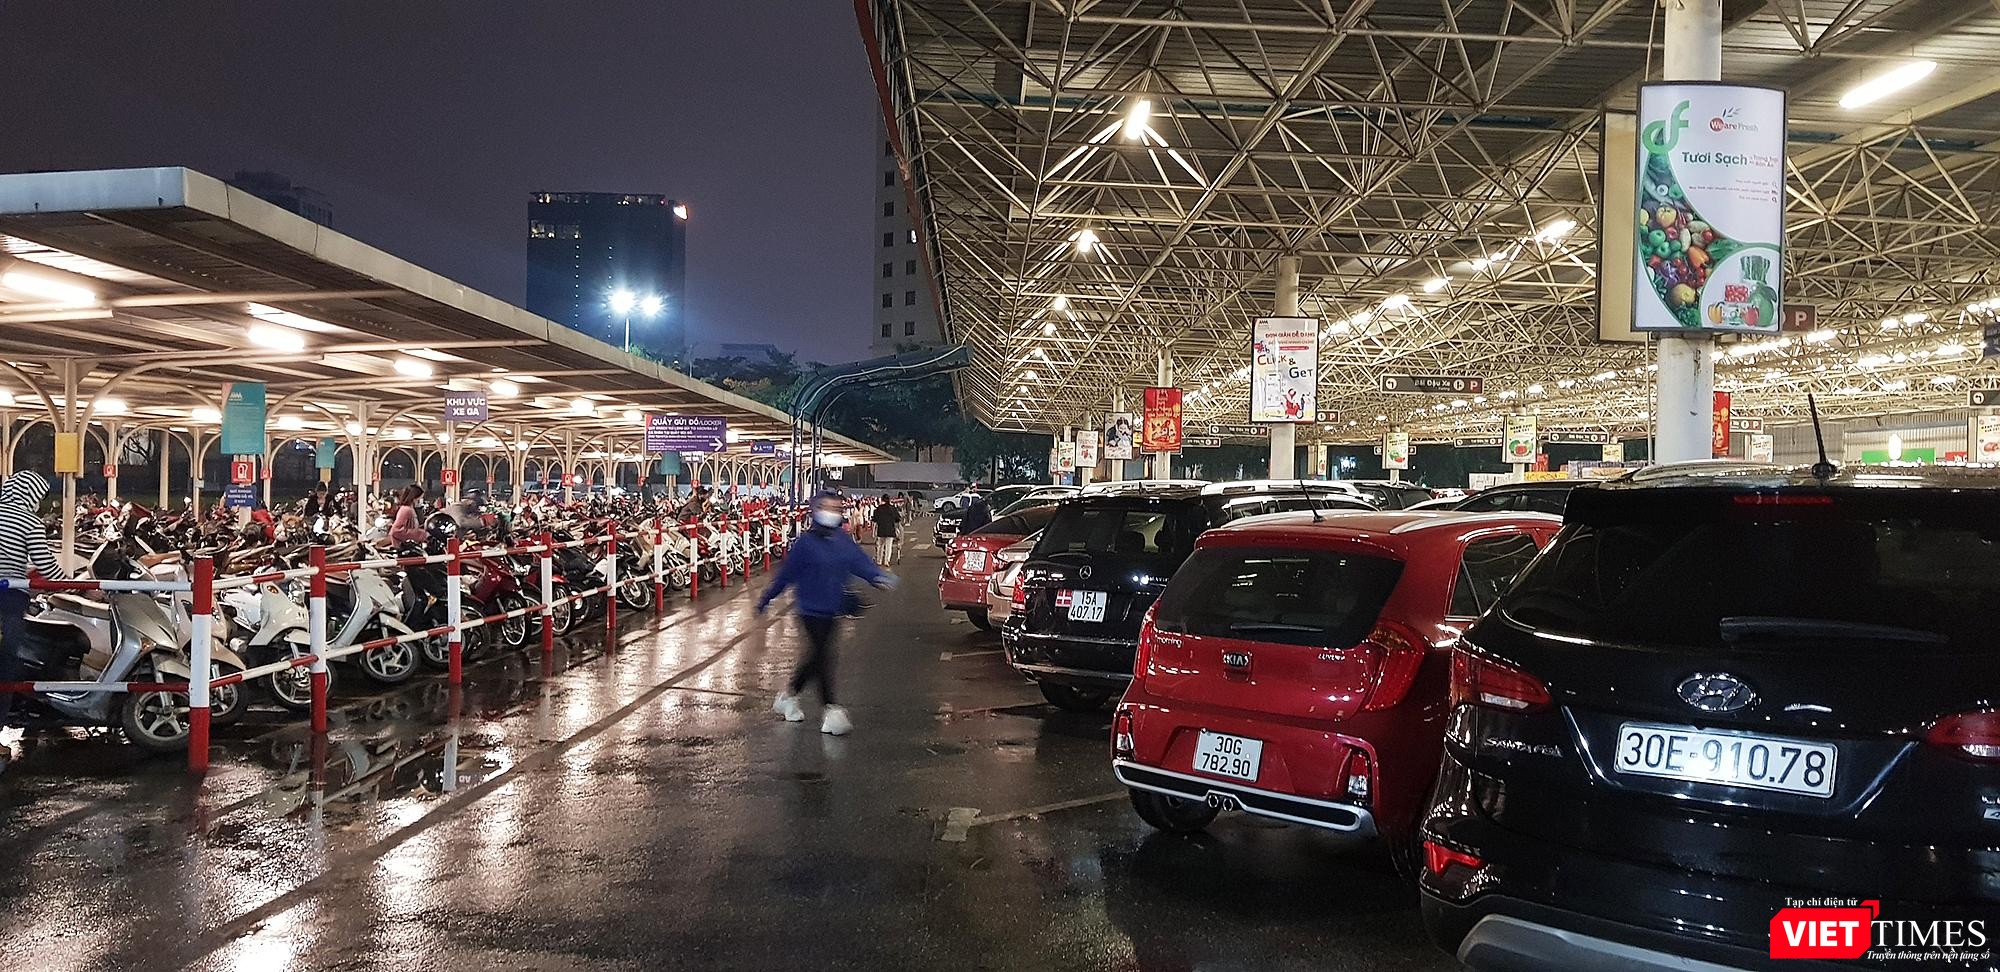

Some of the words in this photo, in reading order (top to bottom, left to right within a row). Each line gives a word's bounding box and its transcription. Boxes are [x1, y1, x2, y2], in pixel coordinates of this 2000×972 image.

[1682, 151, 1711, 163] Tươi
[1715, 153, 1747, 167] Sạch
[1795, 311, 1807, 326] P
[1470, 381, 1478, 390] P
[446, 398, 465, 406] KHU
[466, 396, 486, 407] VỰC
[453, 407, 465, 416] XE
[466, 407, 480, 416] GA
[1082, 592, 1097, 605] 15A
[1071, 605, 1103, 620] 407.17
[1226, 653, 1243, 666] KIA
[1214, 735, 1243, 755] 30G
[1202, 752, 1251, 777] 782.90
[1624, 732, 1826, 787] 30E-910.78
